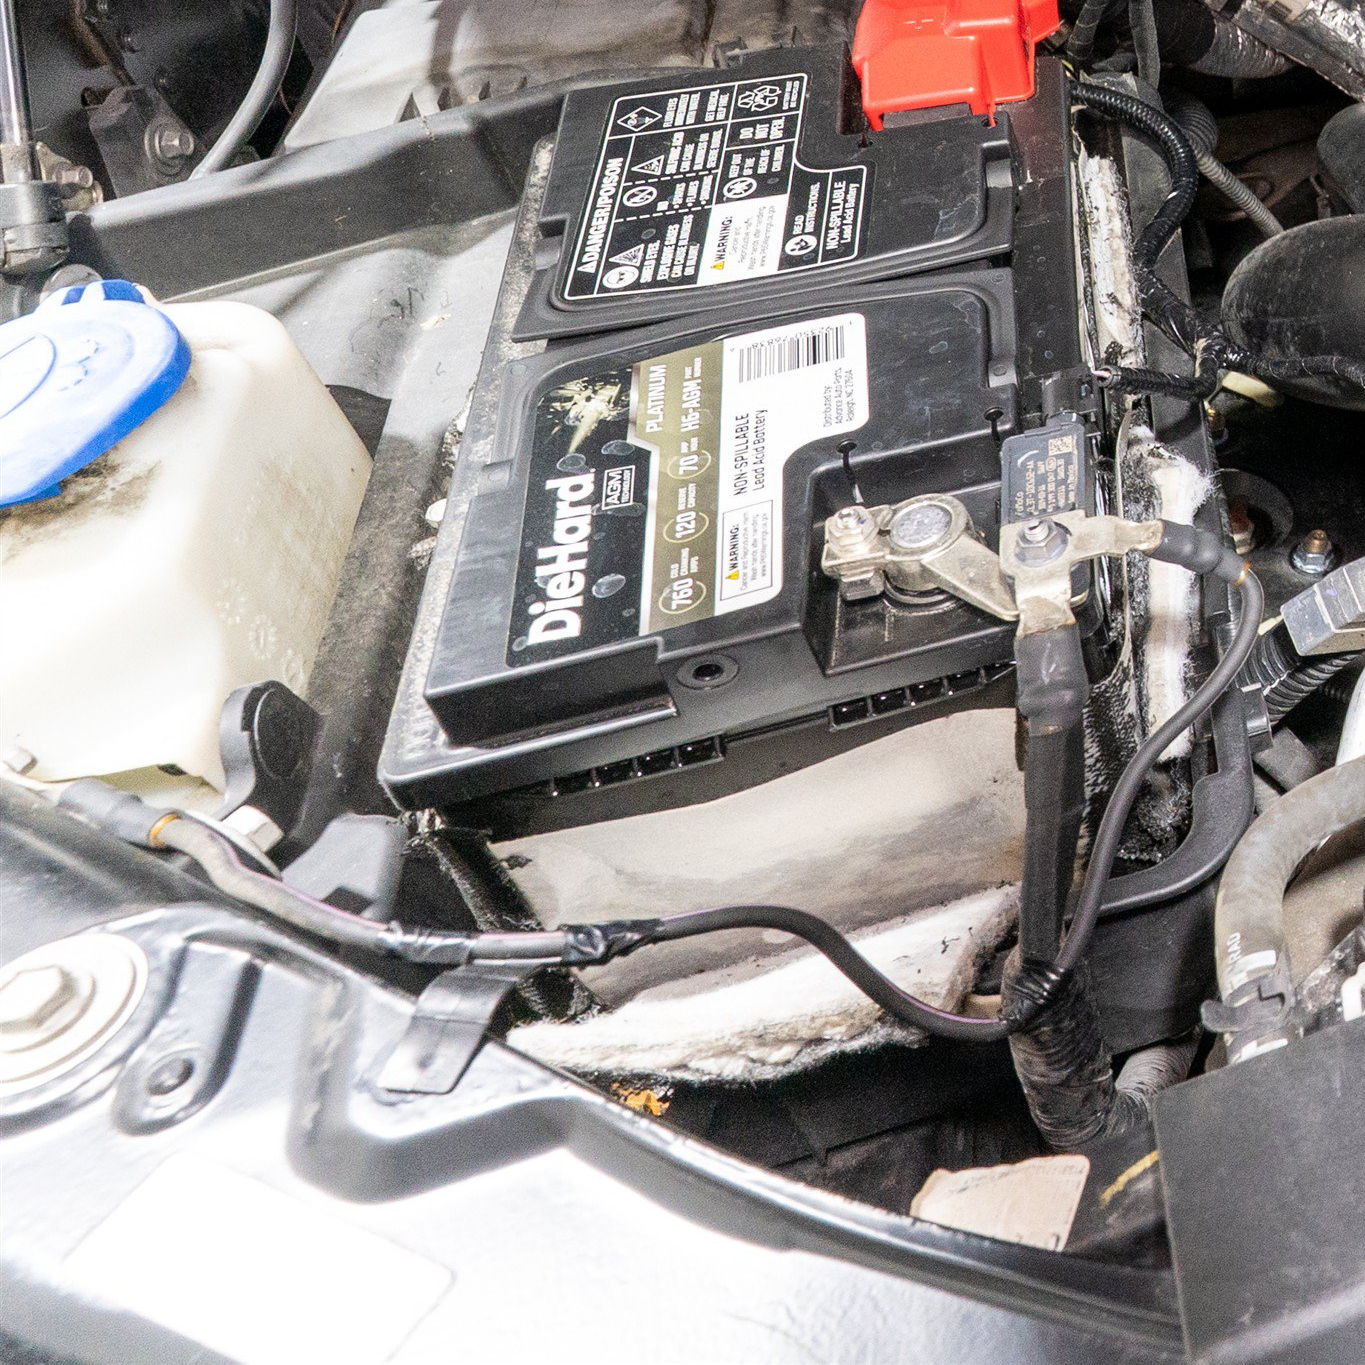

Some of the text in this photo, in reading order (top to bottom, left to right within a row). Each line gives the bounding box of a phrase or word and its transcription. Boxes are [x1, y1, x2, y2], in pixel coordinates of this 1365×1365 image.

[739, 127, 754, 139] DO
[583, 158, 622, 262] DANGER/POISON
[792, 214, 804, 235] READ
[826, 181, 846, 249] NON-SPILLABLE
[840, 183, 860, 243] Lead Acid Battery
[715, 216, 733, 261] WARNING:
[645, 365, 666, 433] PLATINUM
[680, 379, 701, 432] H6-AGM
[678, 454, 699, 475] 70
[733, 413, 749, 495] NON-SPILLABLE
[752, 409, 768, 491] Lead Acid Battery
[606, 469, 622, 504] AGM
[675, 511, 696, 538] 120
[729, 527, 739, 570] WARNING:
[528, 474, 593, 643] DieHard
[671, 578, 693, 609] 760
